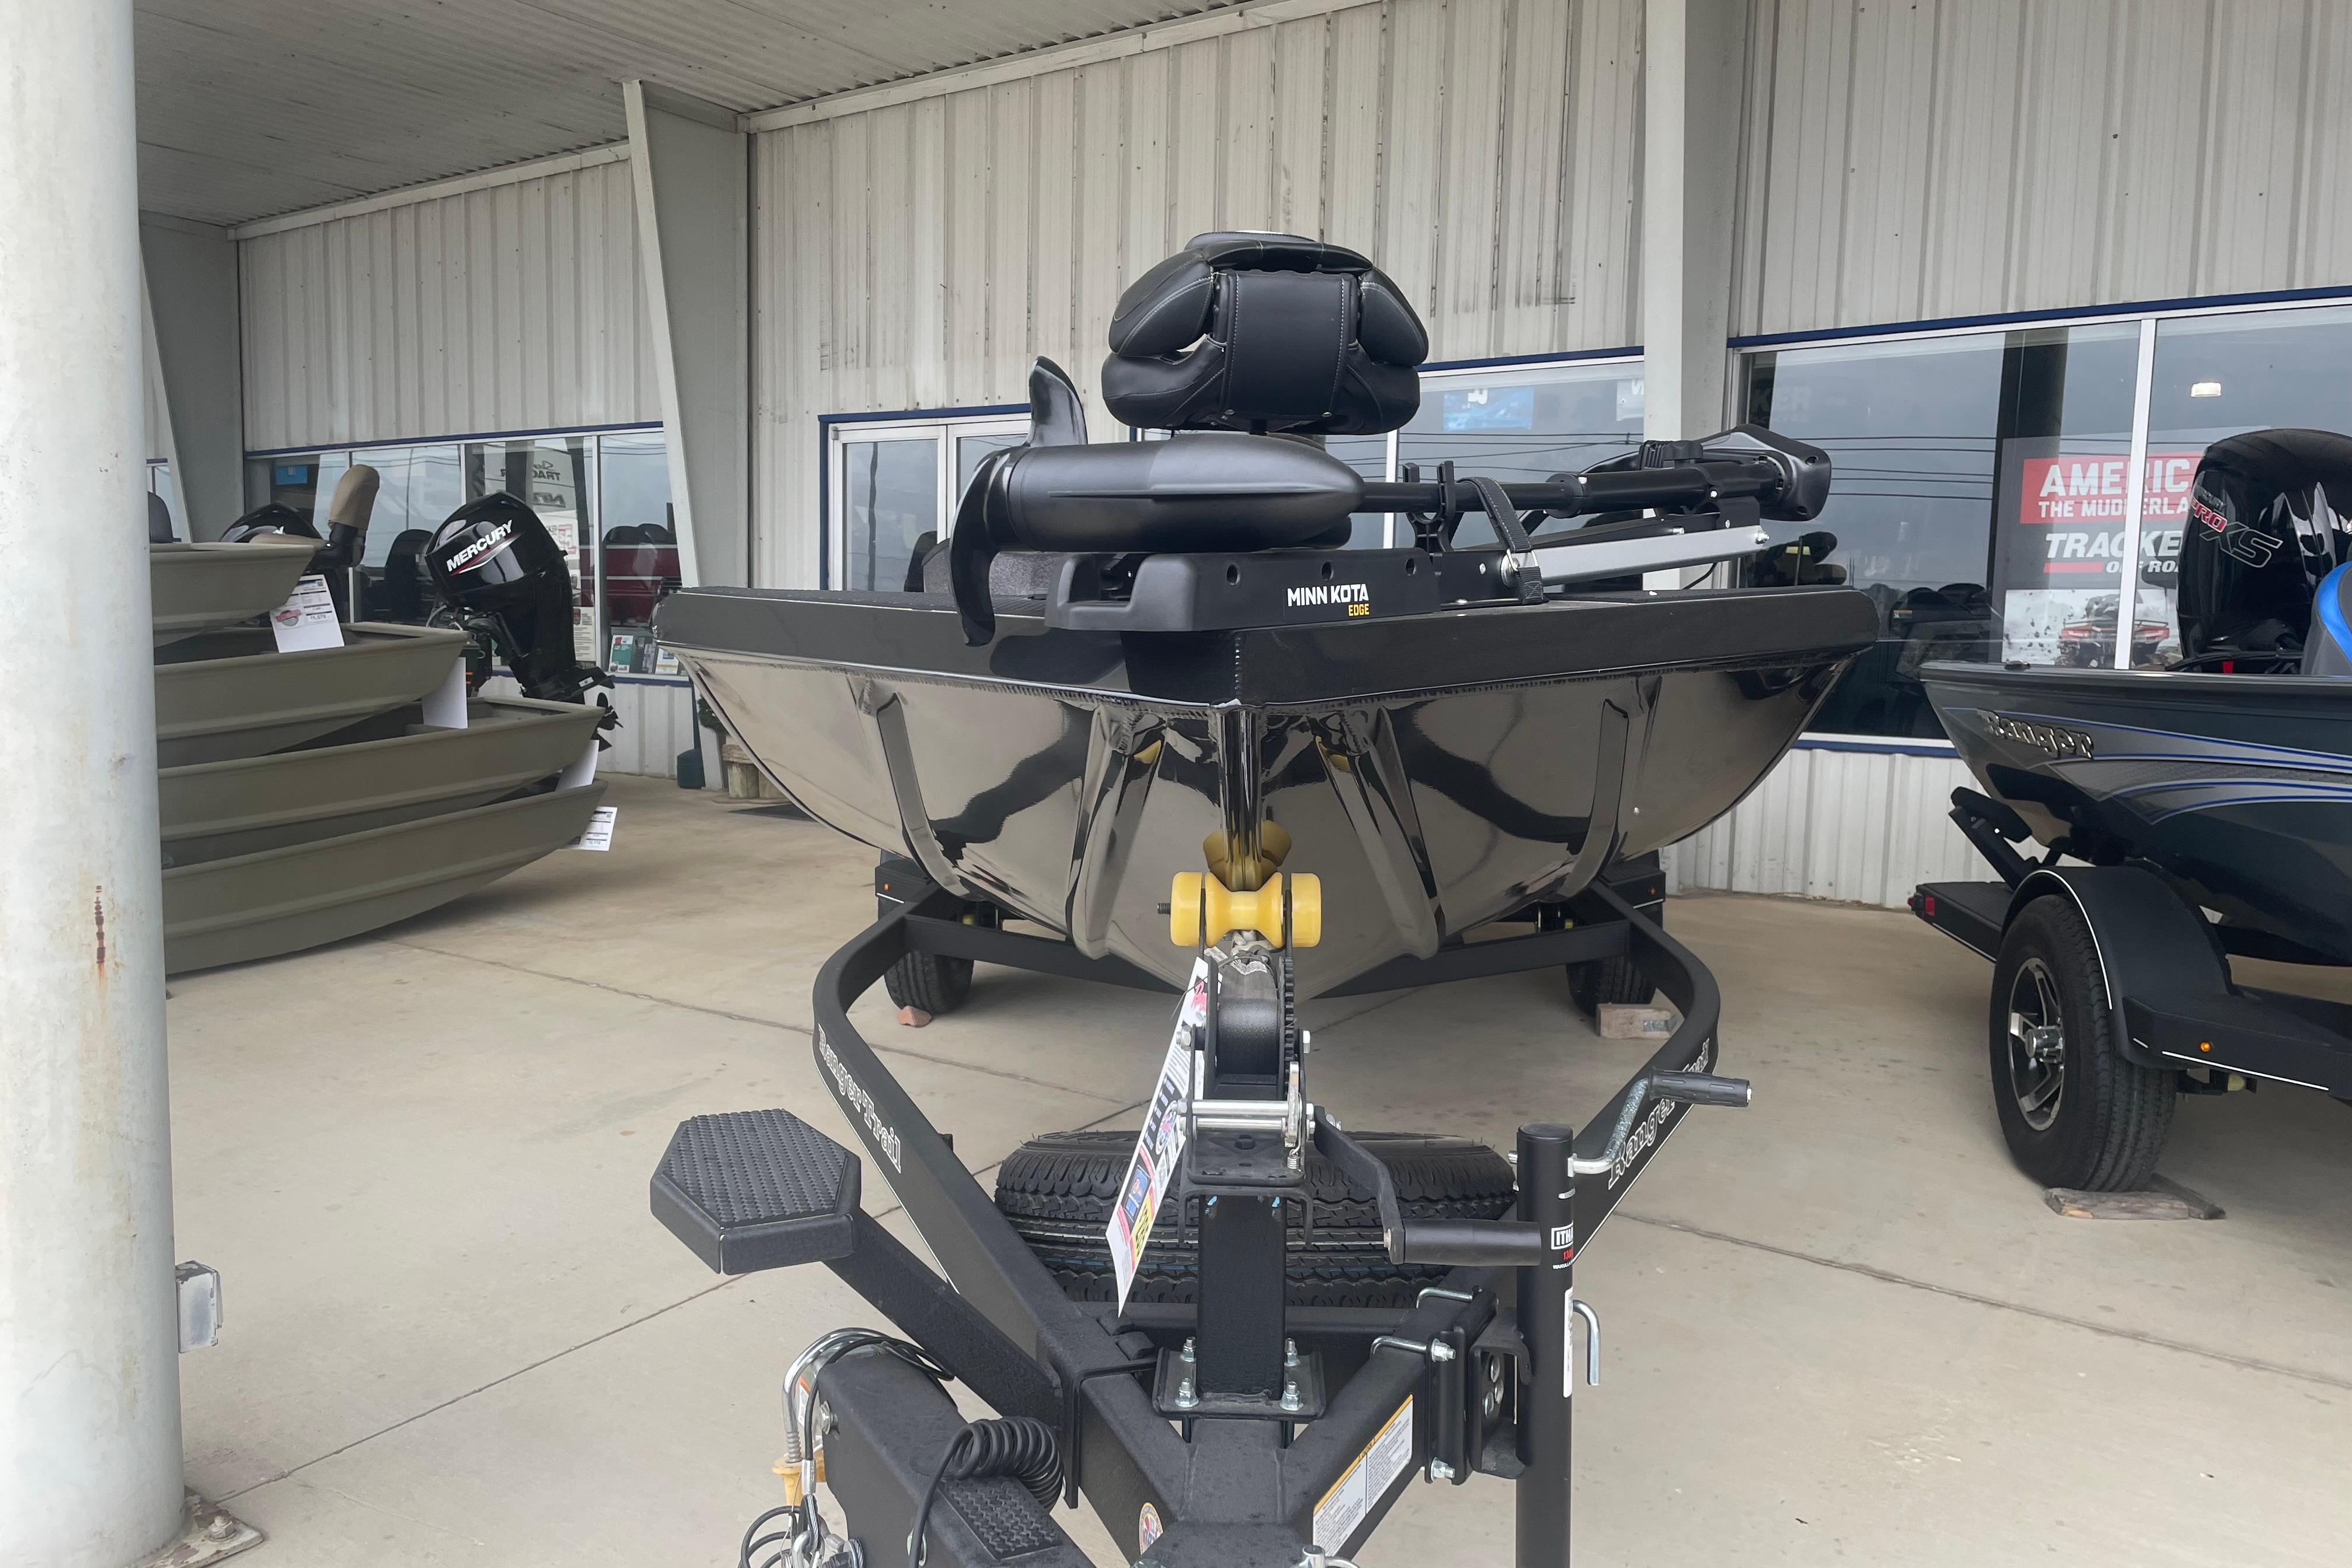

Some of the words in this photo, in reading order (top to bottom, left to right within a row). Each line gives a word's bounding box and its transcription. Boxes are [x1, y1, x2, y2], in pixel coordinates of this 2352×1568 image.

[2039, 500, 2074, 518] THE
[2081, 496, 2188, 517] MUDRLA
[446, 519, 513, 572] MERCURY
[2200, 522, 2283, 568] XS
[1287, 586, 1327, 607] MINN
[1331, 583, 1368, 603] KOTA
[1348, 603, 1370, 617] EDGE
[1978, 709, 2095, 760] Ranger
[818, 1023, 862, 1113] Ranger
[862, 1088, 901, 1174] Trail
[1608, 1098, 1675, 1190] Ranger
